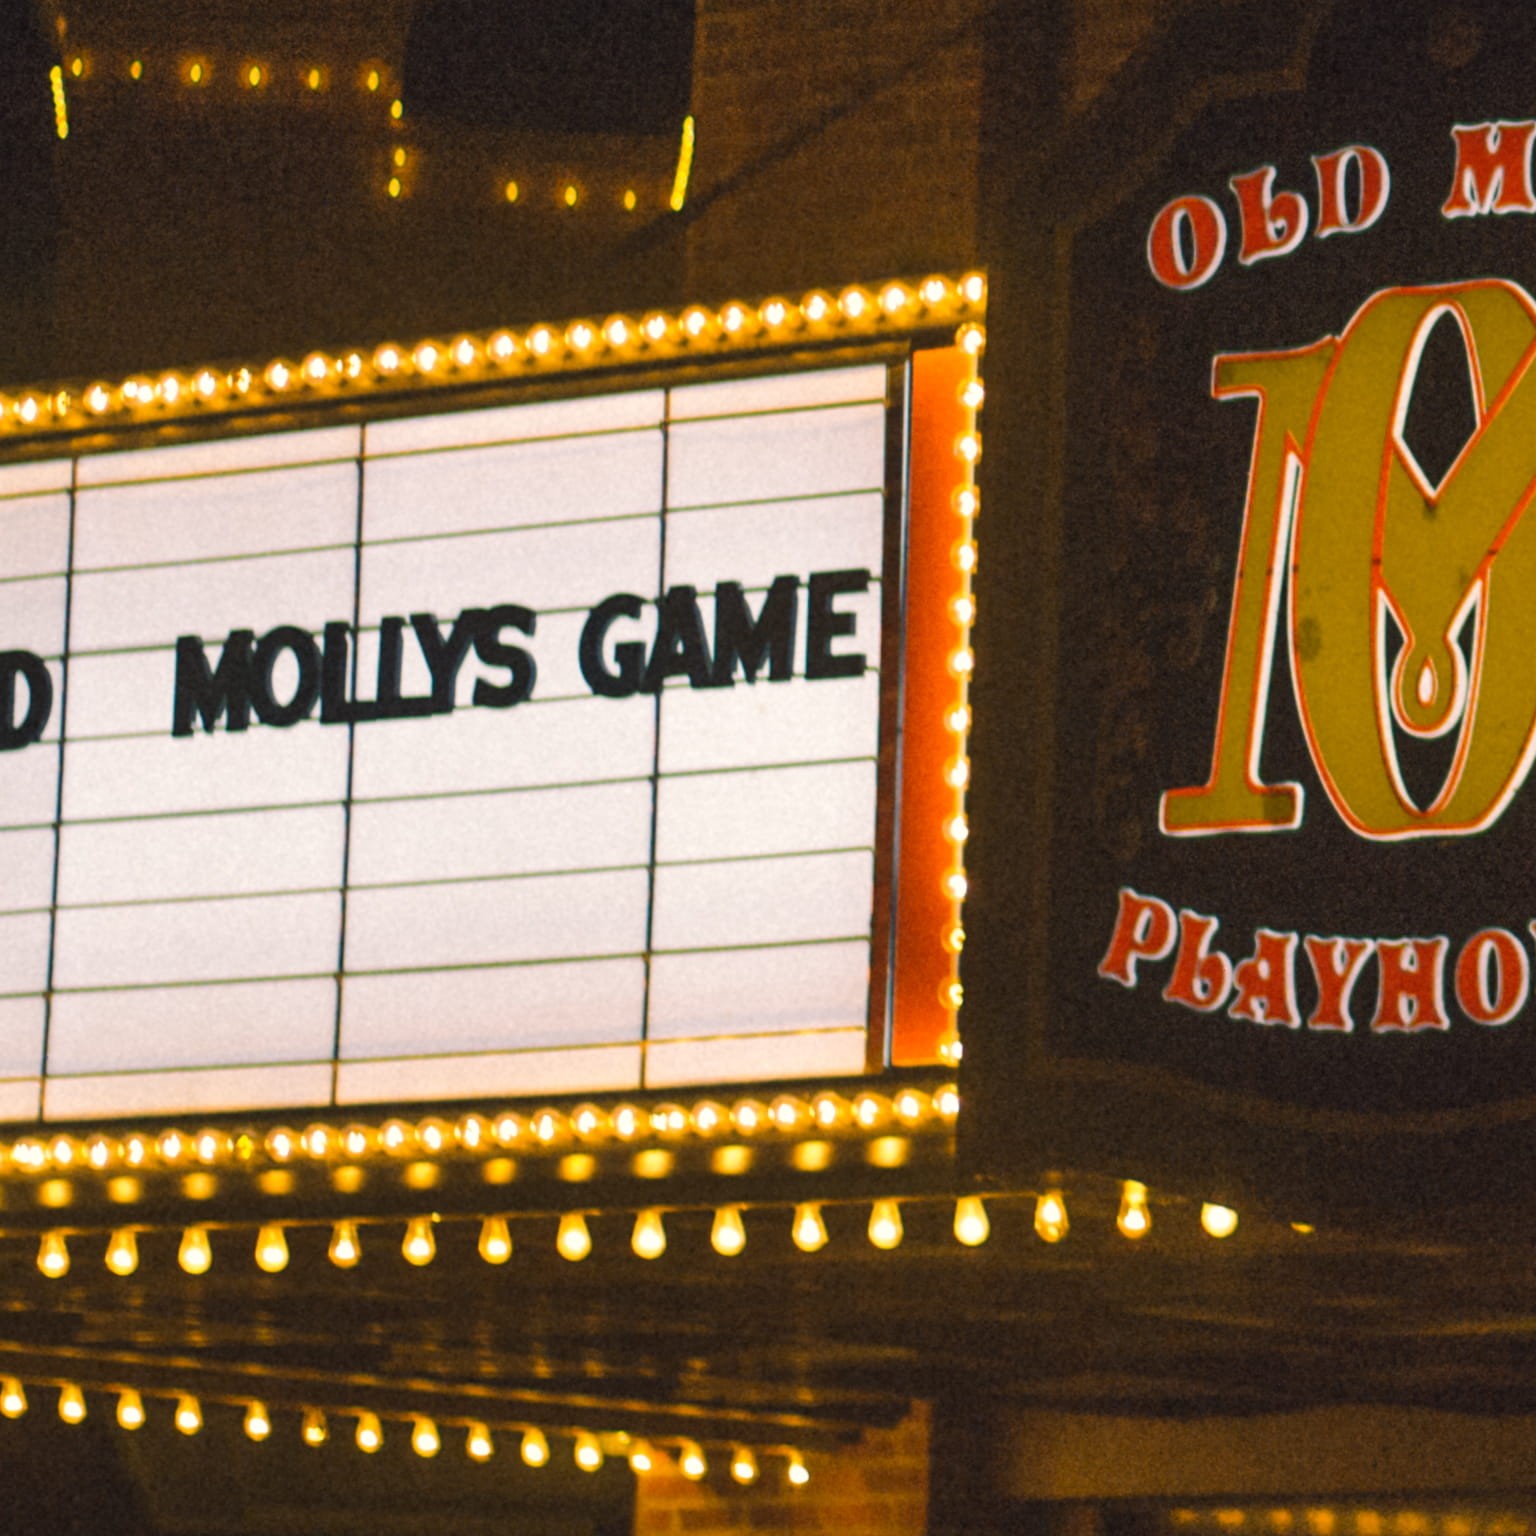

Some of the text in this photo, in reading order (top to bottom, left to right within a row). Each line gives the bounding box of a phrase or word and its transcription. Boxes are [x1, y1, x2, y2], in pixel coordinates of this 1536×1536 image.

[1147, 144, 1391, 290] OLD
[172, 604, 537, 738] MOLLYS
[578, 568, 871, 698] GAME
